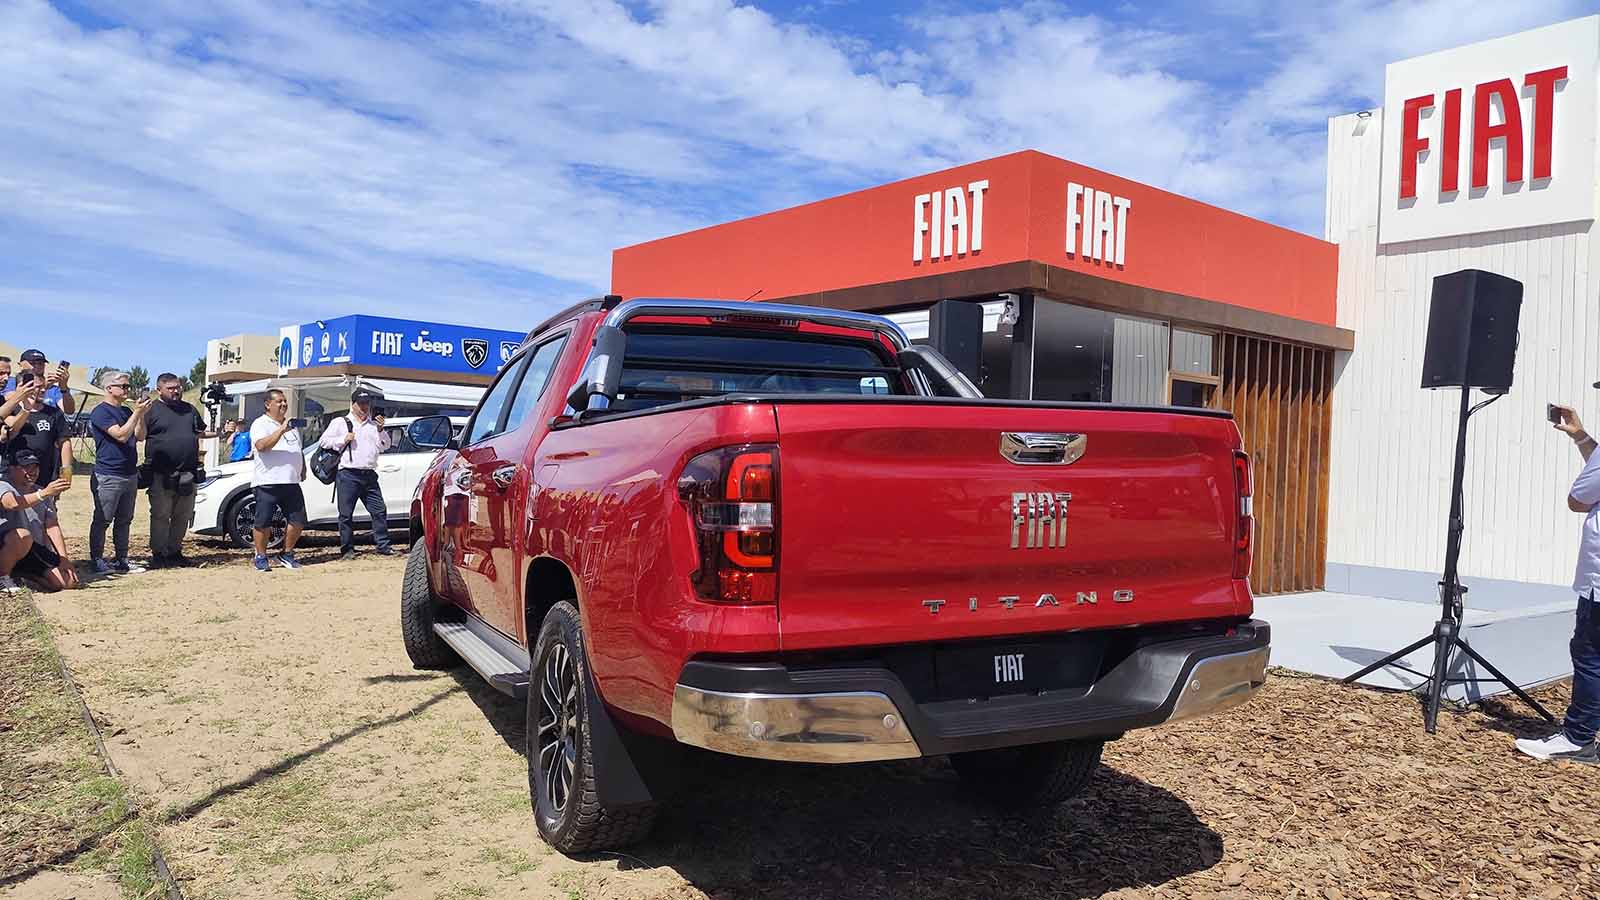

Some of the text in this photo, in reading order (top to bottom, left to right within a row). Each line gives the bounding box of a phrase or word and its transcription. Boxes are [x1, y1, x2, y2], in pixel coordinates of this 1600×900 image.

[1400, 65, 1568, 200] FIAT
[913, 179, 989, 261] FIAT
[1065, 181, 1131, 266] FIAT
[371, 330, 453, 357] FIAT Jeep
[1010, 492, 1072, 549] FIAT
[922, 589, 1135, 614] TITANO
[994, 654, 1025, 683] FIAT
